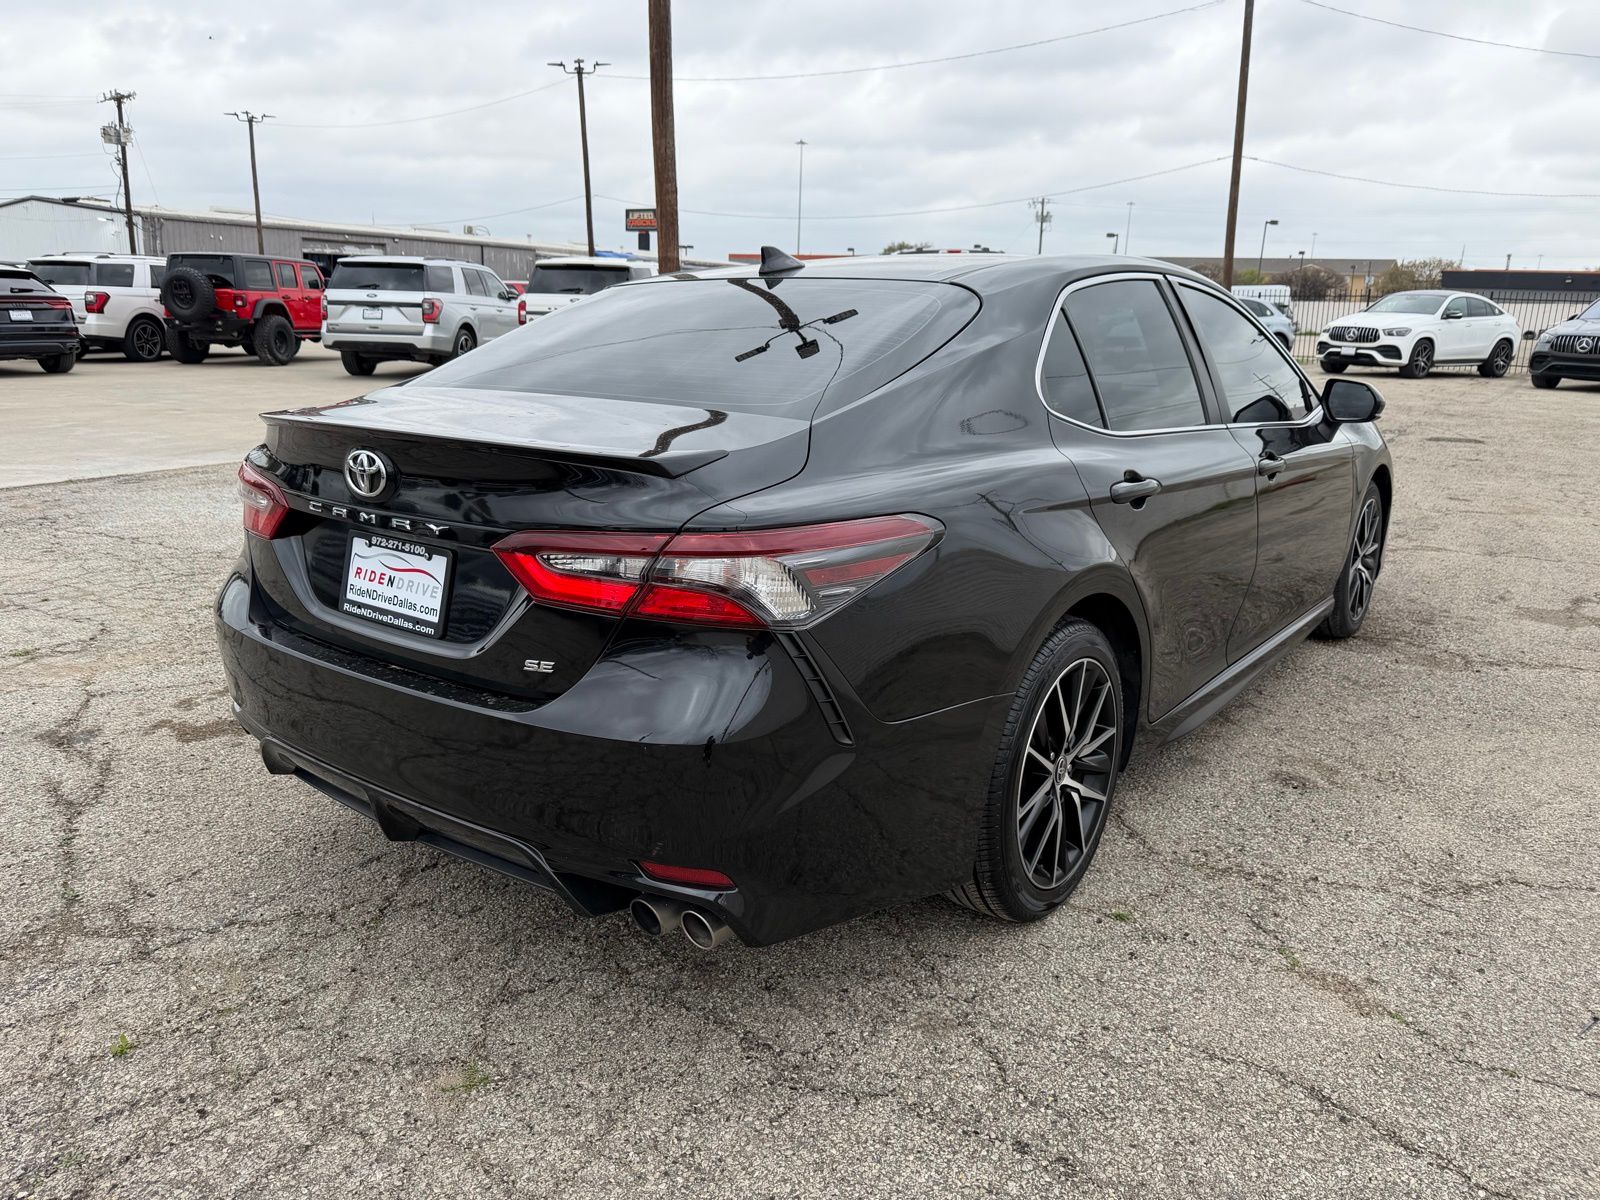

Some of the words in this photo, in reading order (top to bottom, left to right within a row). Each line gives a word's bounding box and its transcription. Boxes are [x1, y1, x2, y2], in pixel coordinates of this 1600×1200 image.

[308, 500, 450, 535] CAMRY
[371, 536, 426, 554] 972-271-5100
[349, 584, 439, 617] RideNDriveDallas.com
[344, 603, 435, 635] RideNDriveDallas.com
[523, 659, 555, 673] SE
